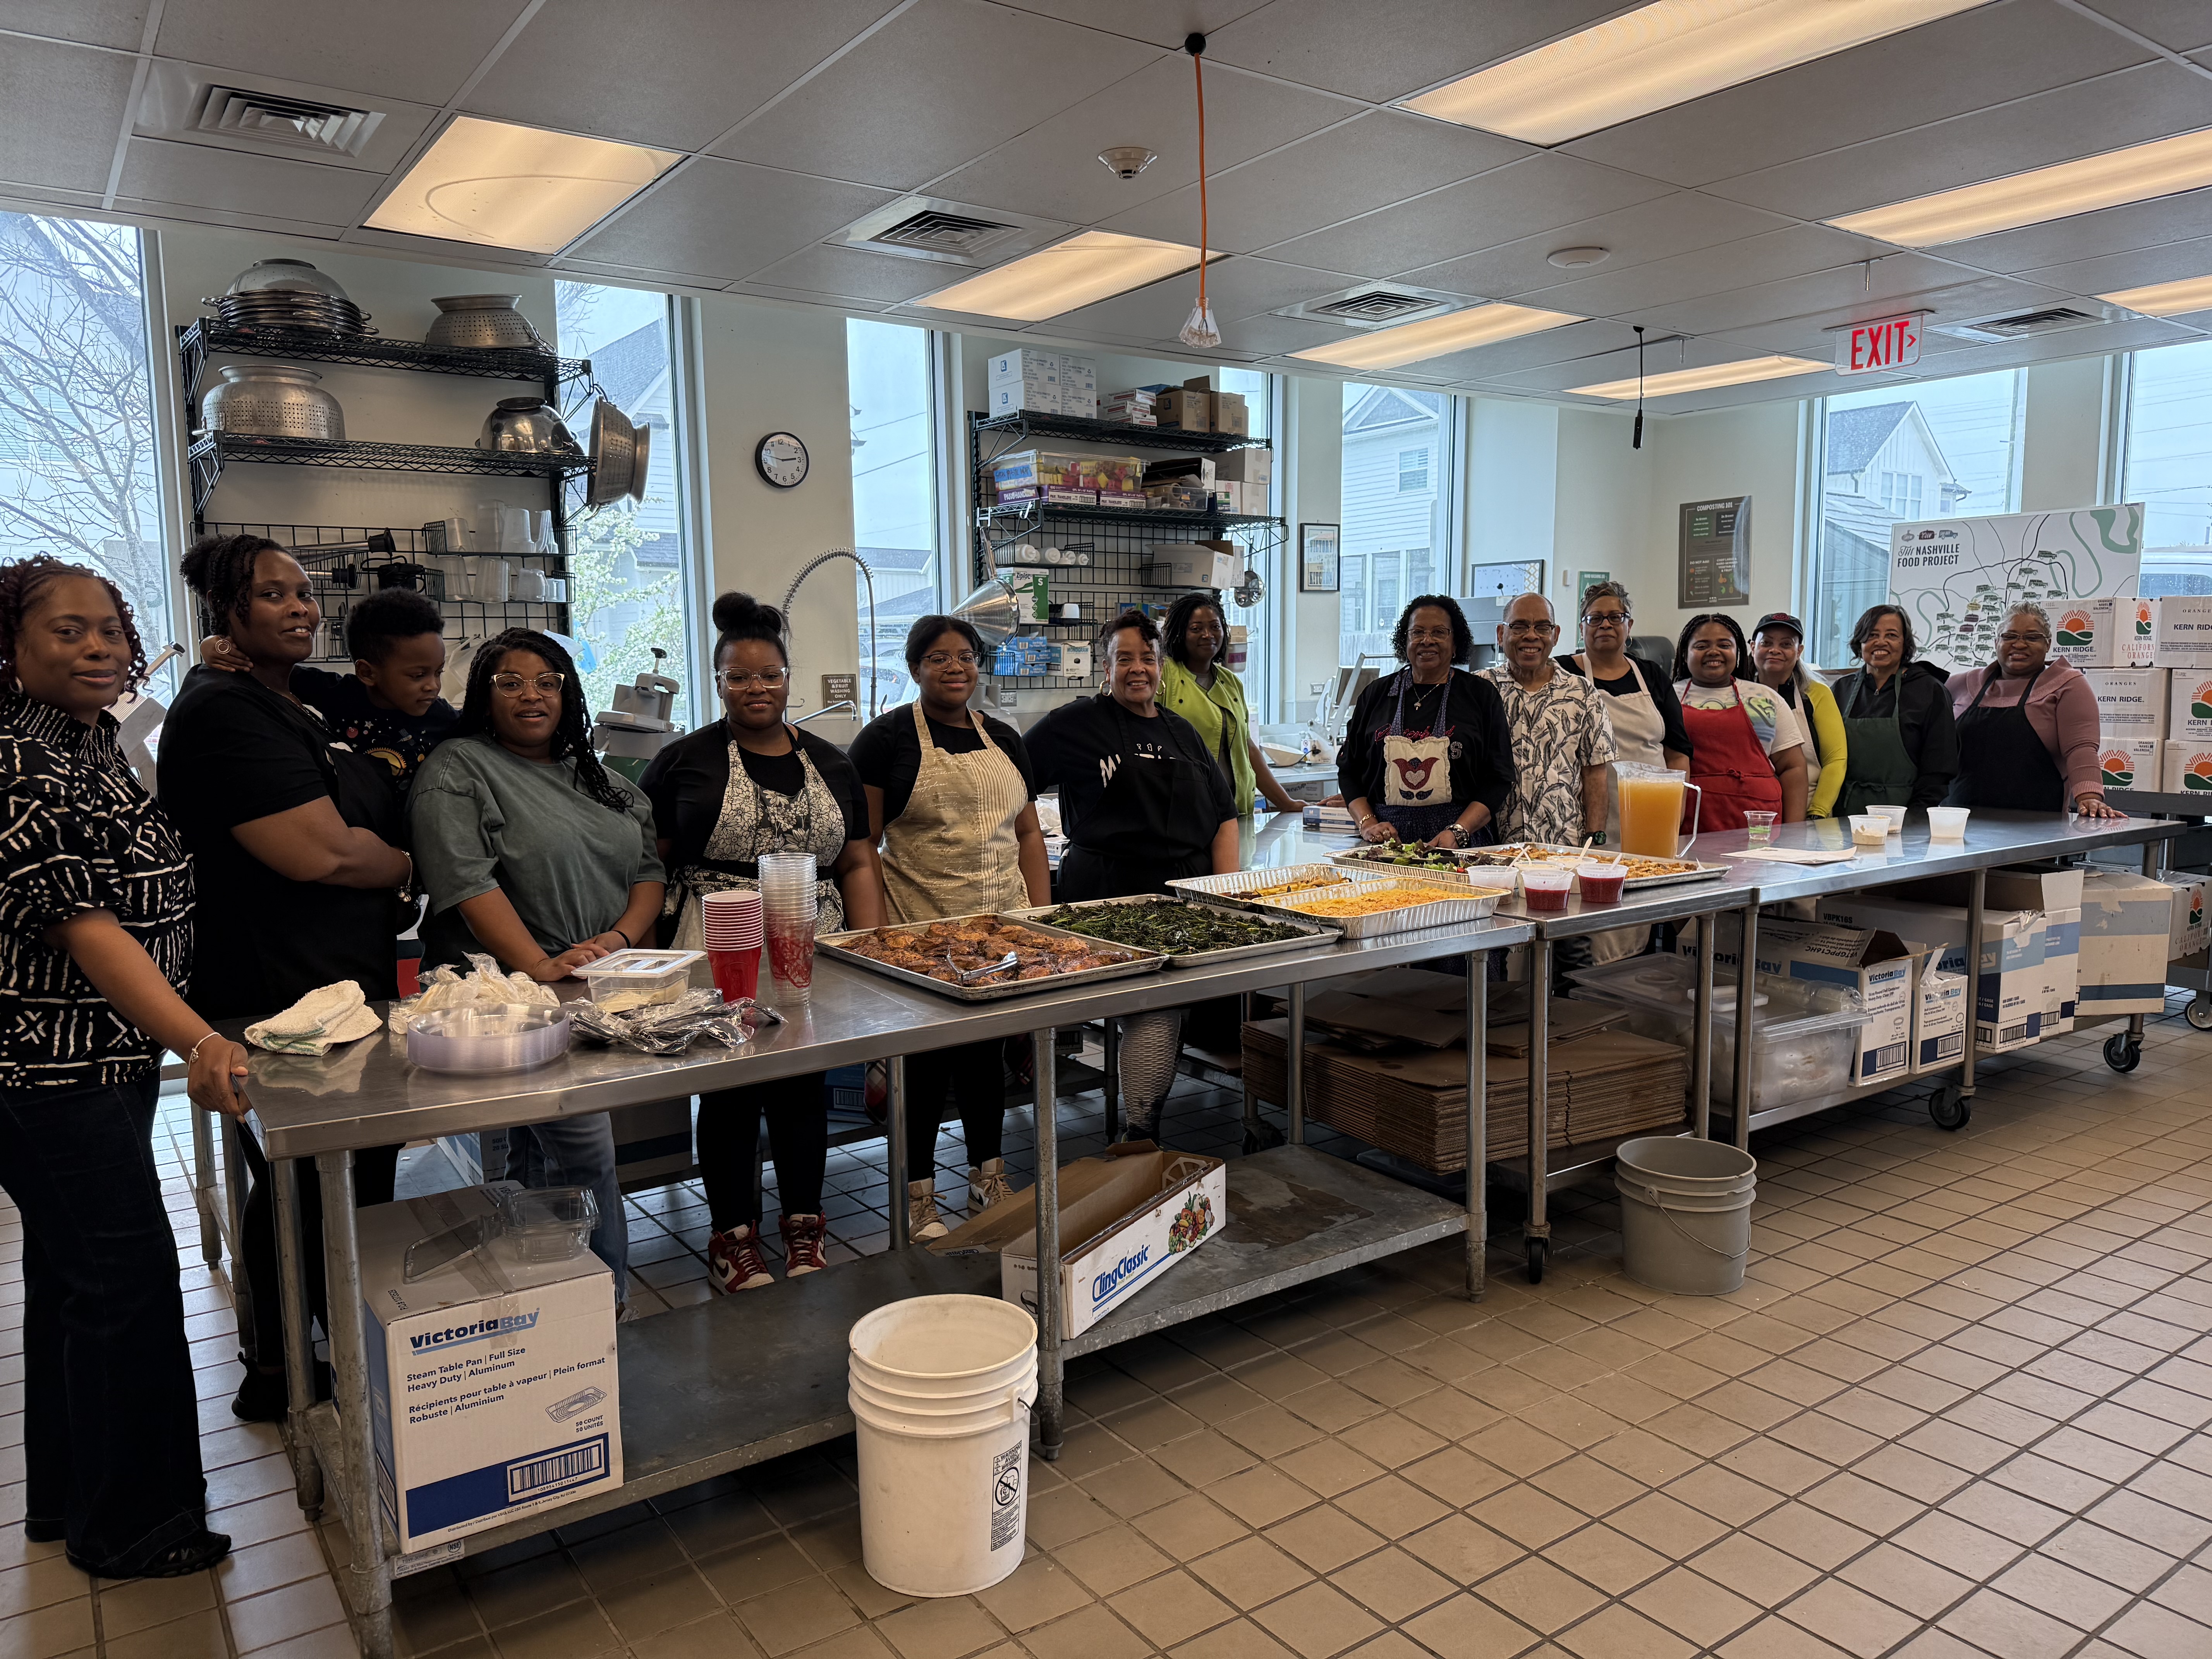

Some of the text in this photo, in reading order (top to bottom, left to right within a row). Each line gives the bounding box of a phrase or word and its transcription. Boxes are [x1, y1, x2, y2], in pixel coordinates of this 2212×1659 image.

[1851, 320, 1910, 370] EXIT
[1697, 503, 1724, 511] COMPOSTING
[1310, 540, 1333, 553] VICTORY
[1898, 543, 1960, 556] The NASHVILLE
[1898, 555, 1959, 567] FOOD PROJECT
[1016, 572, 1030, 580] Ziploc
[1309, 572, 1332, 584] KITCHEN
[1824, 913, 1853, 924] VBPK16S
[1092, 1244, 1149, 1302] ClingClassic
[407, 1348, 526, 1382] Steam Table Pan Full Size
[408, 1361, 515, 1392] Heavy Duty Aluminum
[409, 1397, 457, 1413] Récipients
[460, 1391, 482, 1402] pour
[484, 1382, 507, 1394] table
[516, 1373, 547, 1385] vapeur
[553, 1365, 575, 1376] Plein
[577, 1357, 605, 1370] format
[410, 1395, 504, 1424] Robuste Aluminium
[584, 1415, 603, 1424] COUNT
[584, 1421, 603, 1430] UNITÉS
[1000, 1443, 1021, 1460] WARNING
